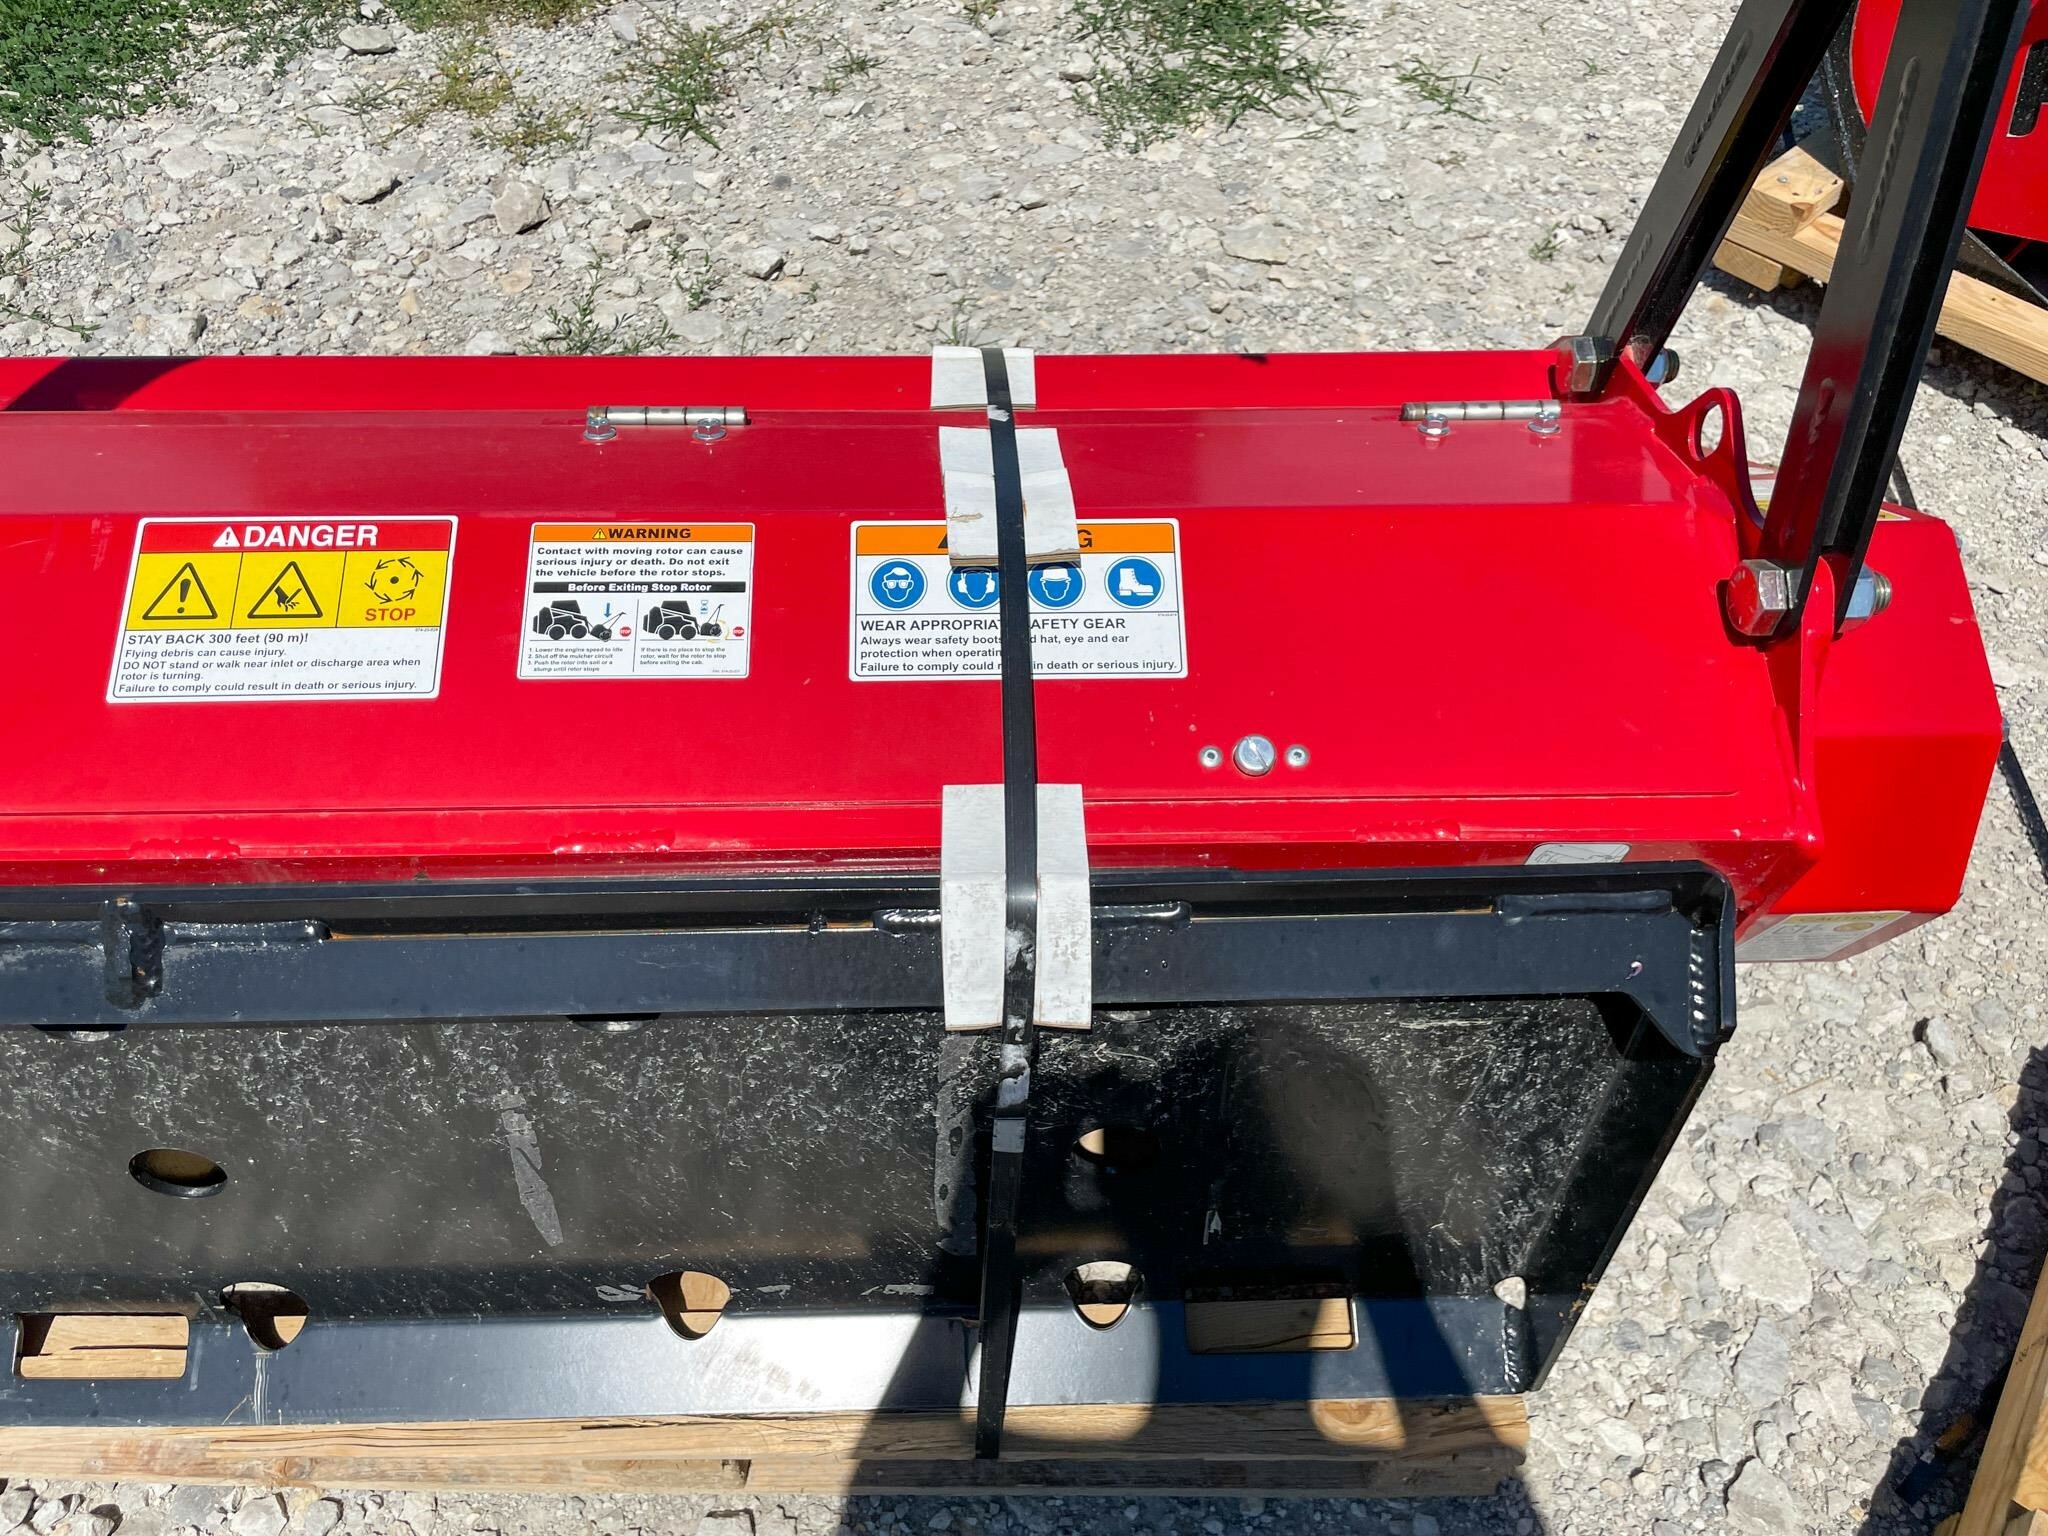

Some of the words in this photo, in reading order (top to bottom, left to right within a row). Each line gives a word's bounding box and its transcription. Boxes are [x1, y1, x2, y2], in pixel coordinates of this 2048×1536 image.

[243, 525, 379, 547] DANGER
[608, 528, 692, 539] WARNING
[537, 547, 582, 555] Contact
[585, 547, 609, 555] with
[613, 547, 652, 556] moving
[580, 558, 612, 567] injury
[691, 569, 726, 577] stops.
[608, 583, 648, 592] Exiting
[651, 583, 677, 592] Stop
[680, 583, 712, 591] Rotor
[365, 608, 416, 621] STOP
[860, 620, 906, 631] WEAR
[910, 620, 1000, 630] APPROPRIA
[1030, 618, 1078, 629] AFETY
[1083, 618, 1126, 629] GEAR
[128, 634, 162, 644] STAY
[165, 634, 205, 644] BACK
[208, 634, 232, 644] 300
[235, 633, 260, 644] feet
[264, 633, 283, 646] (90
[287, 633, 309, 645] m)!
[860, 636, 901, 646] Always
[935, 636, 969, 646] safety
[1040, 635, 1060, 644] hat,
[1064, 636, 1084, 645] eye
[1087, 634, 1108, 643] and
[1111, 635, 1130, 643] ear
[125, 649, 158, 660] Flying
[160, 648, 194, 658] debris
[254, 648, 287, 658] injury.
[860, 650, 918, 660] protection
[921, 649, 952, 657] when
[956, 648, 1002, 658] operatin
[122, 662, 140, 670] DO
[142, 661, 166, 669] NOT
[170, 660, 198, 669] stand
[217, 660, 240, 668] walk
[270, 659, 293, 667] inlet
[310, 658, 364, 668] discharge
[392, 658, 421, 666] when
[860, 663, 899, 671] Failure
[902, 663, 914, 671] to
[917, 662, 959, 672] comply
[962, 662, 994, 670] could
[1033, 661, 1043, 669] in
[1047, 660, 1078, 669] death
[1097, 660, 1139, 668] serious
[1142, 660, 1177, 670] injury.
[150, 672, 159, 680] is
[162, 672, 204, 682] turning.
[119, 684, 156, 692] Failure
[172, 684, 211, 693] comply
[214, 683, 245, 691] could
[247, 682, 278, 690] result
[281, 682, 291, 690] in
[294, 682, 324, 690] death
[342, 681, 381, 689] serious
[384, 680, 417, 690] injury.
